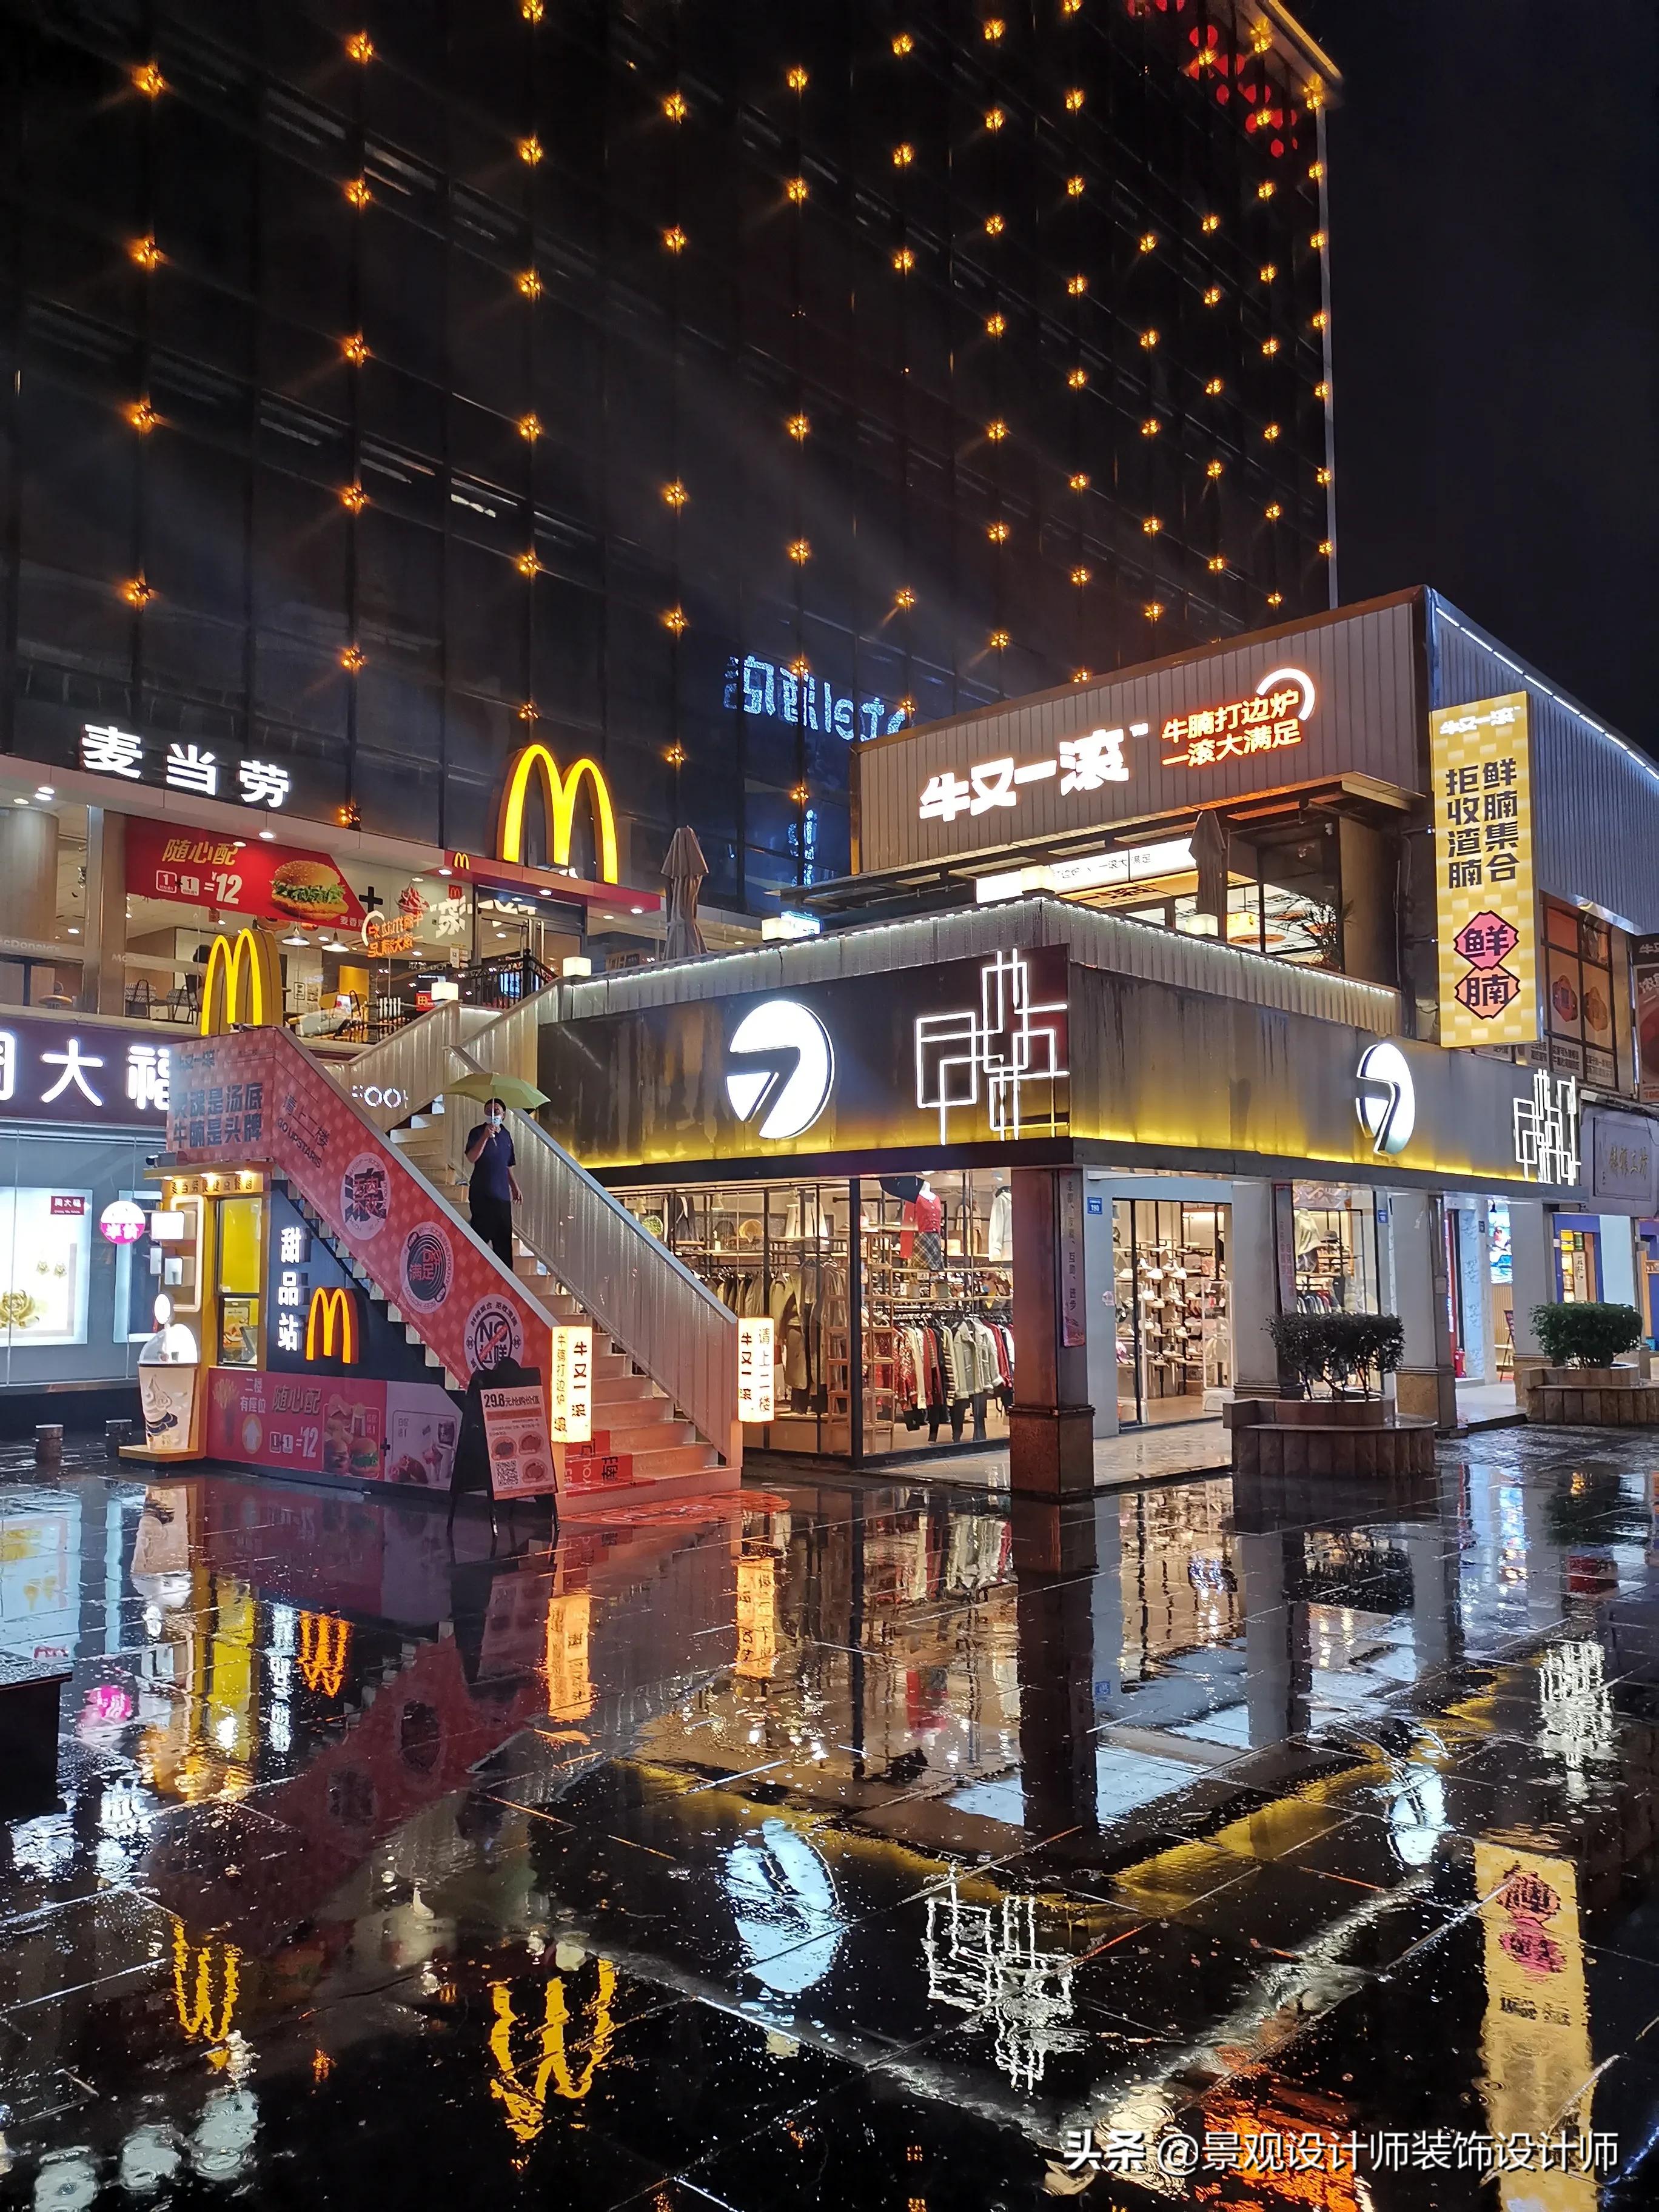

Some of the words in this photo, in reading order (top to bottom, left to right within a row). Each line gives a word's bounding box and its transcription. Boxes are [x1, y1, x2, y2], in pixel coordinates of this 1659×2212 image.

[1162, 689, 1299, 743] 牛腩打边炉
[1162, 719, 1302, 767] 一滚大满足
[81, 723, 292, 808] 麦当劳
[918, 729, 1131, 822] 牛又一滚
[162, 839, 239, 865] 随心配
[1446, 765, 1483, 888] 拒收渣腩
[1483, 757, 1520, 883] 鲜腩集合
[0, 1031, 170, 1111] 大福
[277, 1225, 302, 1353] 甜品站
[271, 1384, 322, 1415] 随心配
